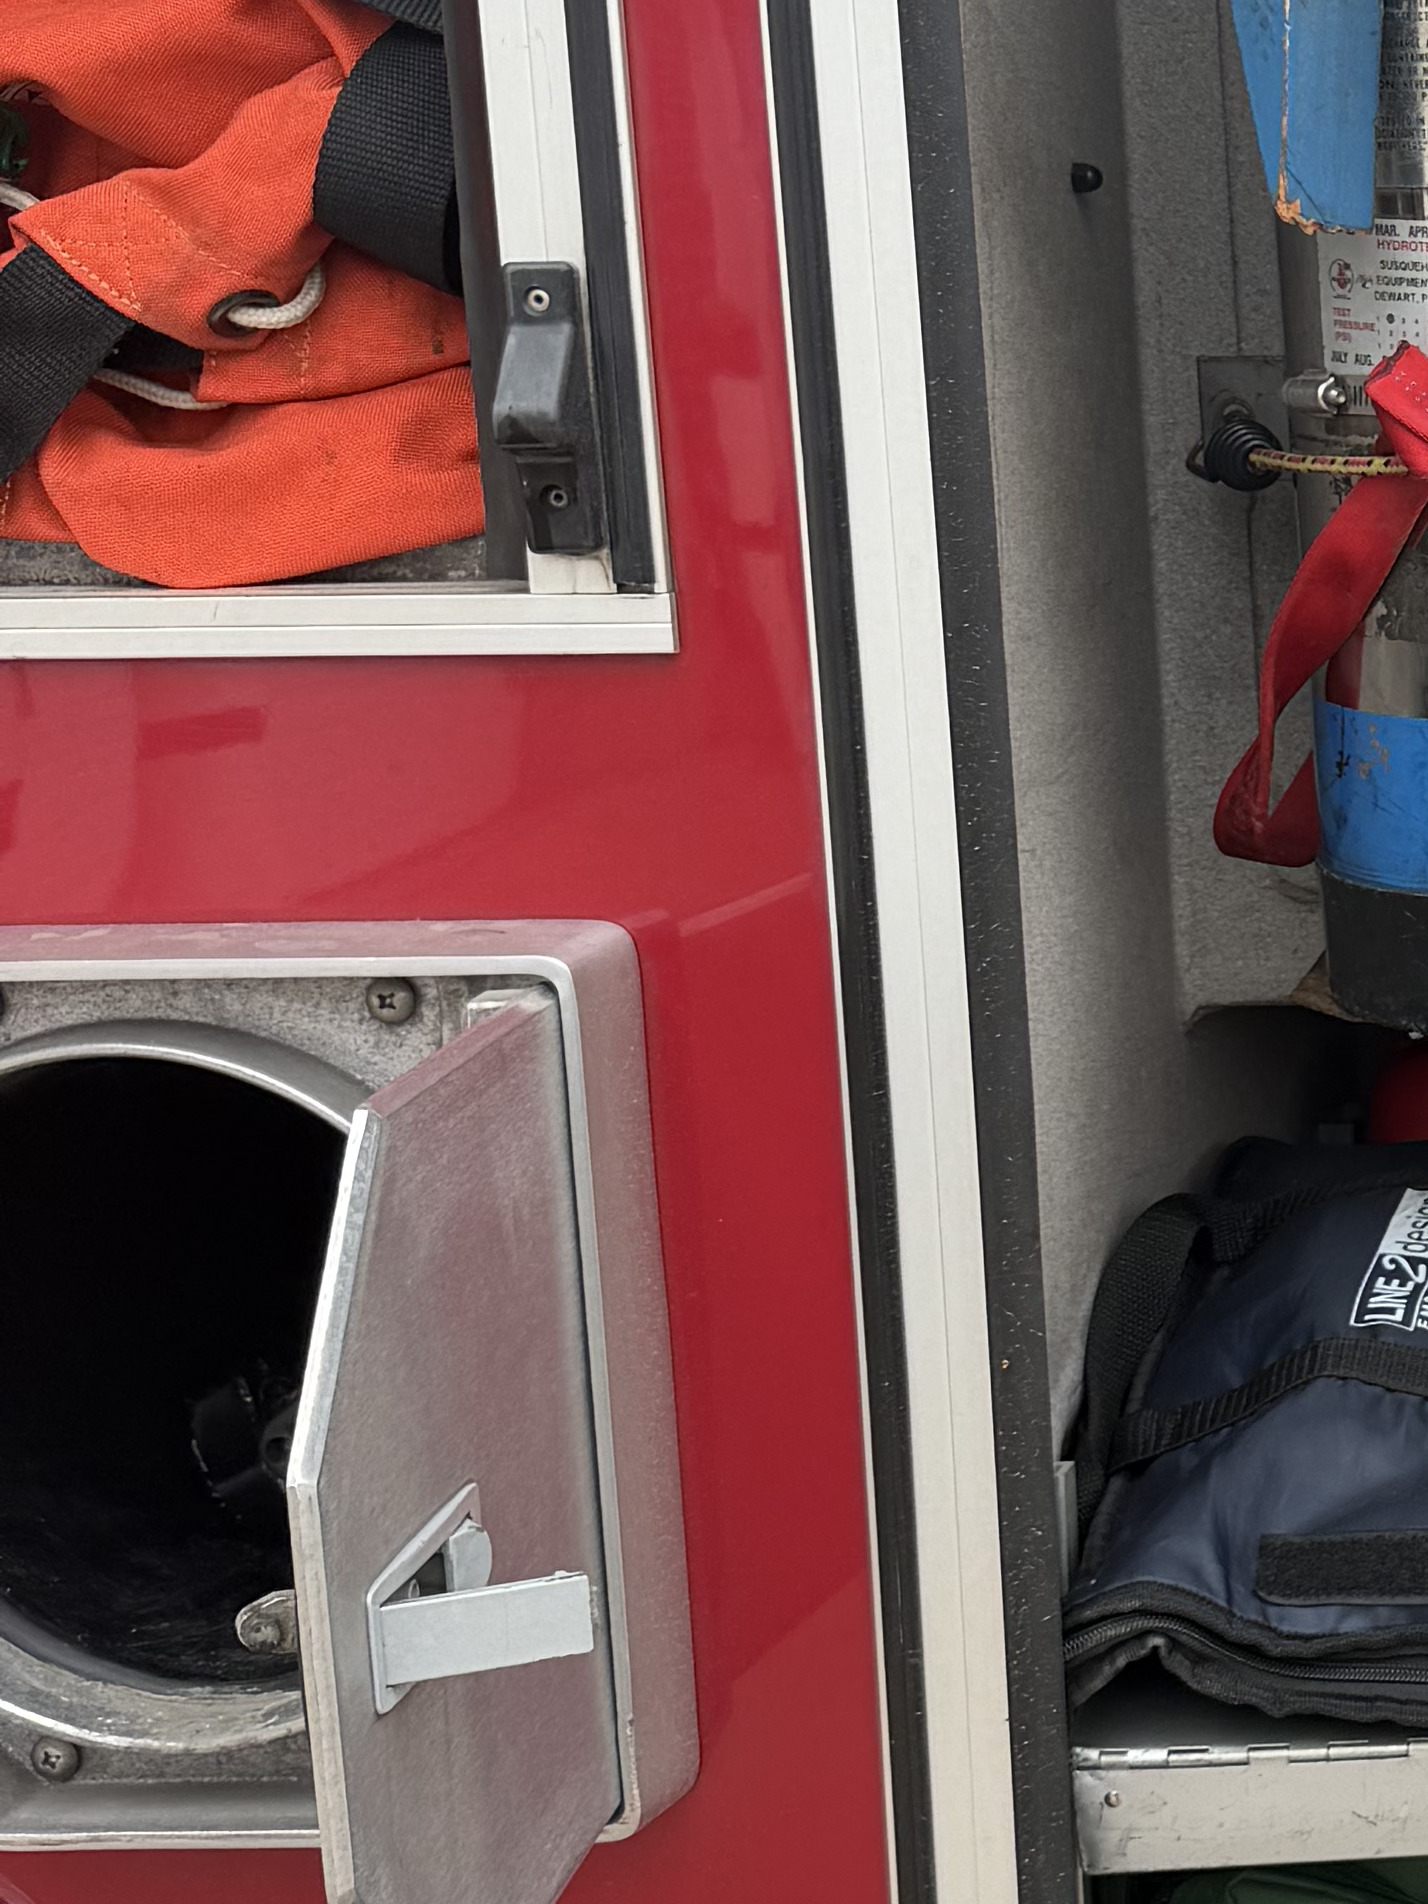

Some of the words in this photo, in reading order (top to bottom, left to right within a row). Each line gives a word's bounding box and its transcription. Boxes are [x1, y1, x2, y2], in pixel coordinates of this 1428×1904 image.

[1374, 226, 1400, 236] MAR.
[1374, 291, 1419, 303] DEWART,
[1333, 308, 1351, 317] TEST
[1333, 319, 1376, 332] PRESSURE
[1354, 352, 1375, 366] AUG.
